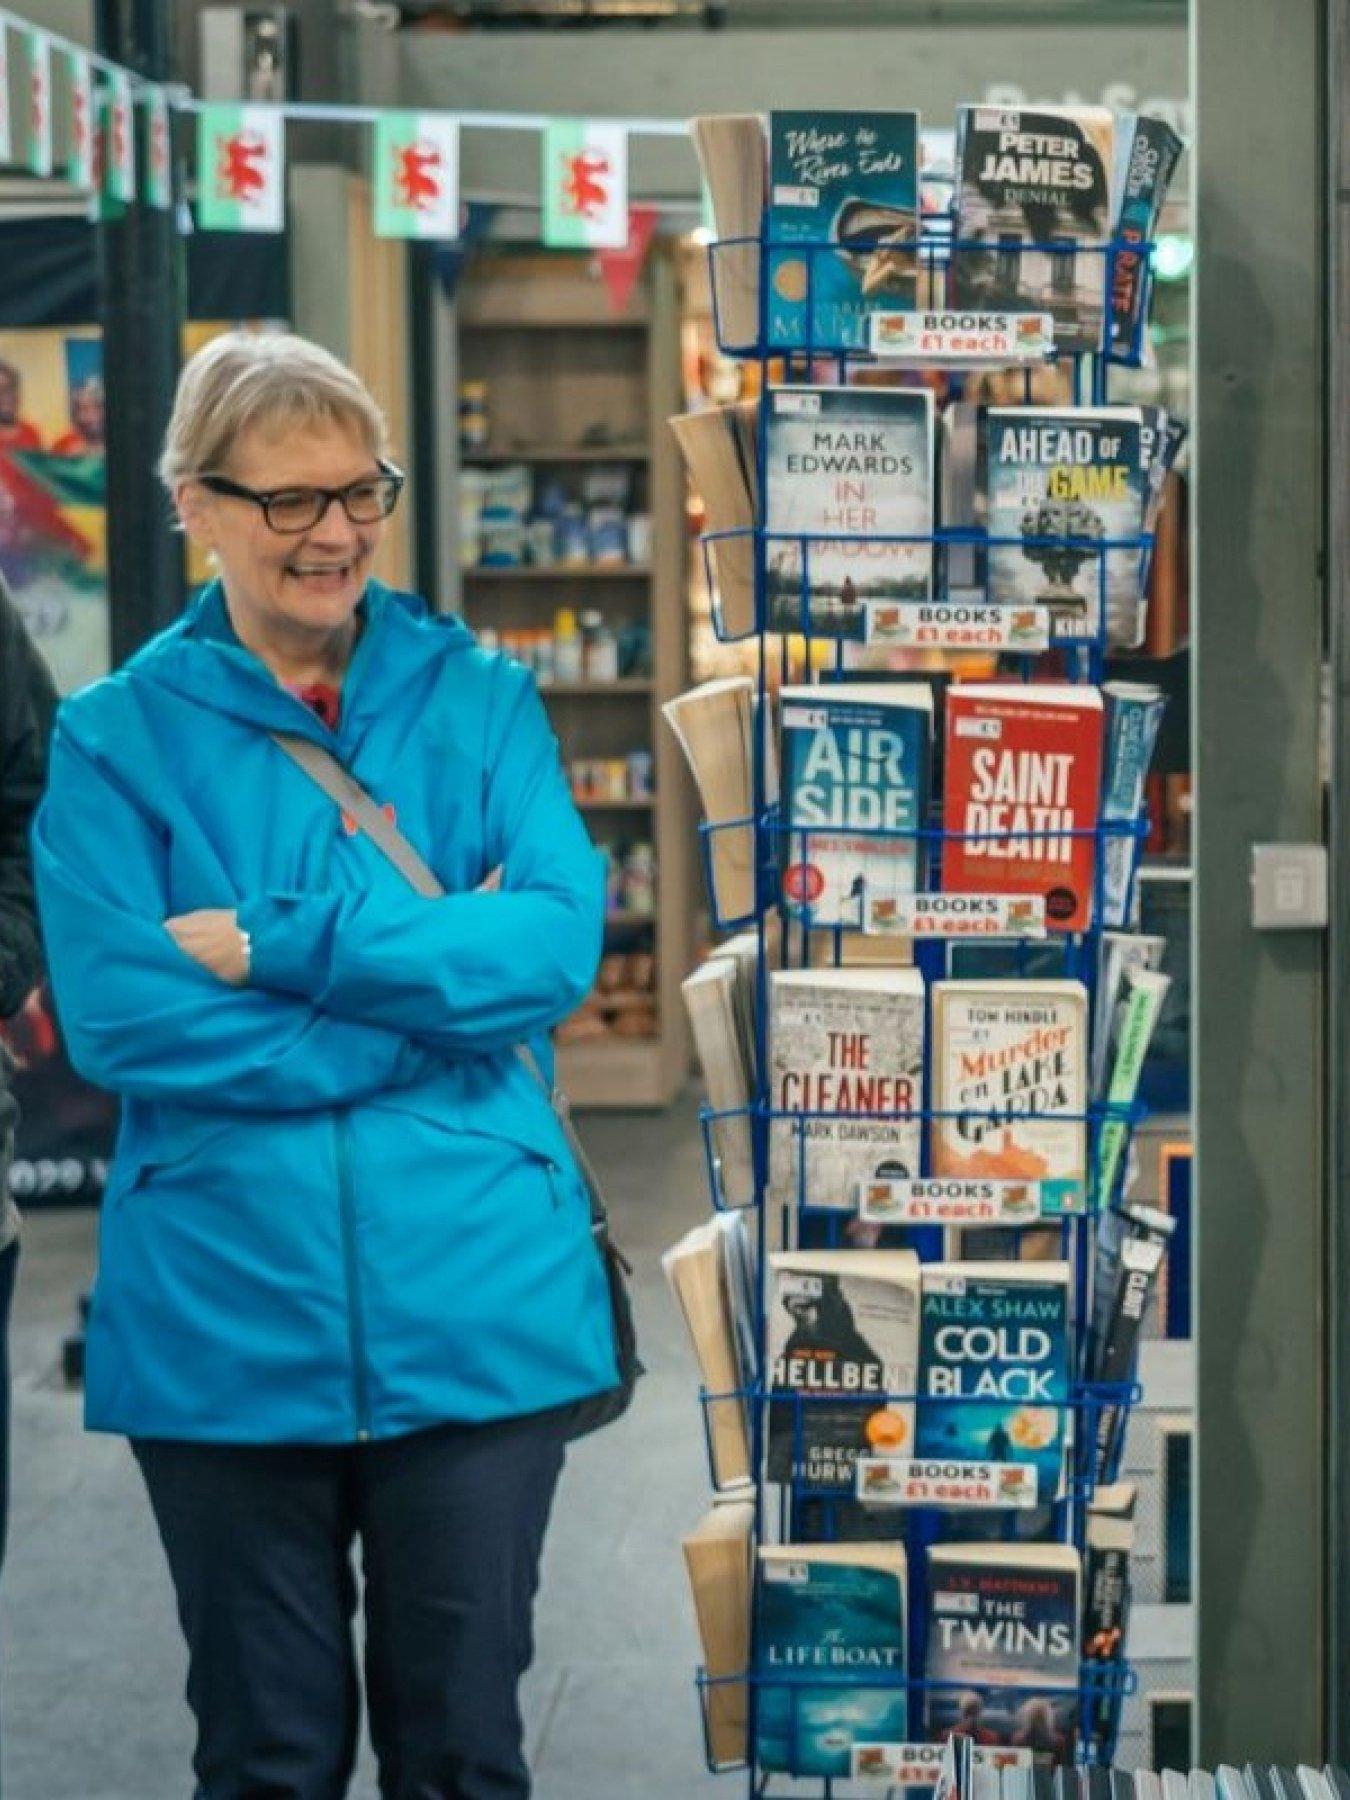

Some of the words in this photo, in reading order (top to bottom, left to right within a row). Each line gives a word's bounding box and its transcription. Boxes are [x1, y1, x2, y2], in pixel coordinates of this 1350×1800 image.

[1001, 133, 1079, 159] PETER
[979, 154, 1095, 189] JAMES
[924, 315, 1007, 331] BOOKS
[922, 334, 942, 350] £1
[951, 334, 1007, 351] each
[814, 432, 887, 451] MARK
[1001, 428, 1093, 464] AHEAD
[786, 454, 913, 475] EDWARDS
[837, 479, 866, 502] IN
[1047, 466, 1131, 499] GAME
[823, 508, 877, 530] HER
[919, 607, 1002, 623] BOOKS
[917, 627, 939, 642] £1
[945, 627, 1002, 643] each
[804, 728, 906, 785] AIR
[969, 748, 1075, 806] SAINT
[792, 785, 915, 829] SIDE
[963, 800, 1075, 864] DEATH
[915, 898, 999, 914] BOOKS
[914, 916, 935, 932] £1
[942, 917, 999, 933] each
[827, 1032, 871, 1070] THE
[959, 1026, 1073, 1082] Murder
[1003, 1050, 1072, 1096] LAKE
[780, 1072, 915, 1122] CLEANER
[839, 1122, 901, 1143] DAWSON
[911, 1182, 994, 1198] BOOKS
[909, 1201, 931, 1217] £1
[937, 1202, 994, 1218] each
[923, 1298, 984, 1318] ALEX
[992, 1299, 1062, 1321] SHAW
[934, 1324, 1051, 1361] COLD
[928, 1365, 1057, 1400] BLACK
[907, 1464, 991, 1480] BOOKS
[906, 1482, 928, 1498] £1
[934, 1483, 991, 1500] each
[984, 1601, 1026, 1618] THE
[938, 1618, 1072, 1656] TWINS
[768, 1644, 899, 1667] LIFEBOAT
[902, 1747, 984, 1764] BOS
